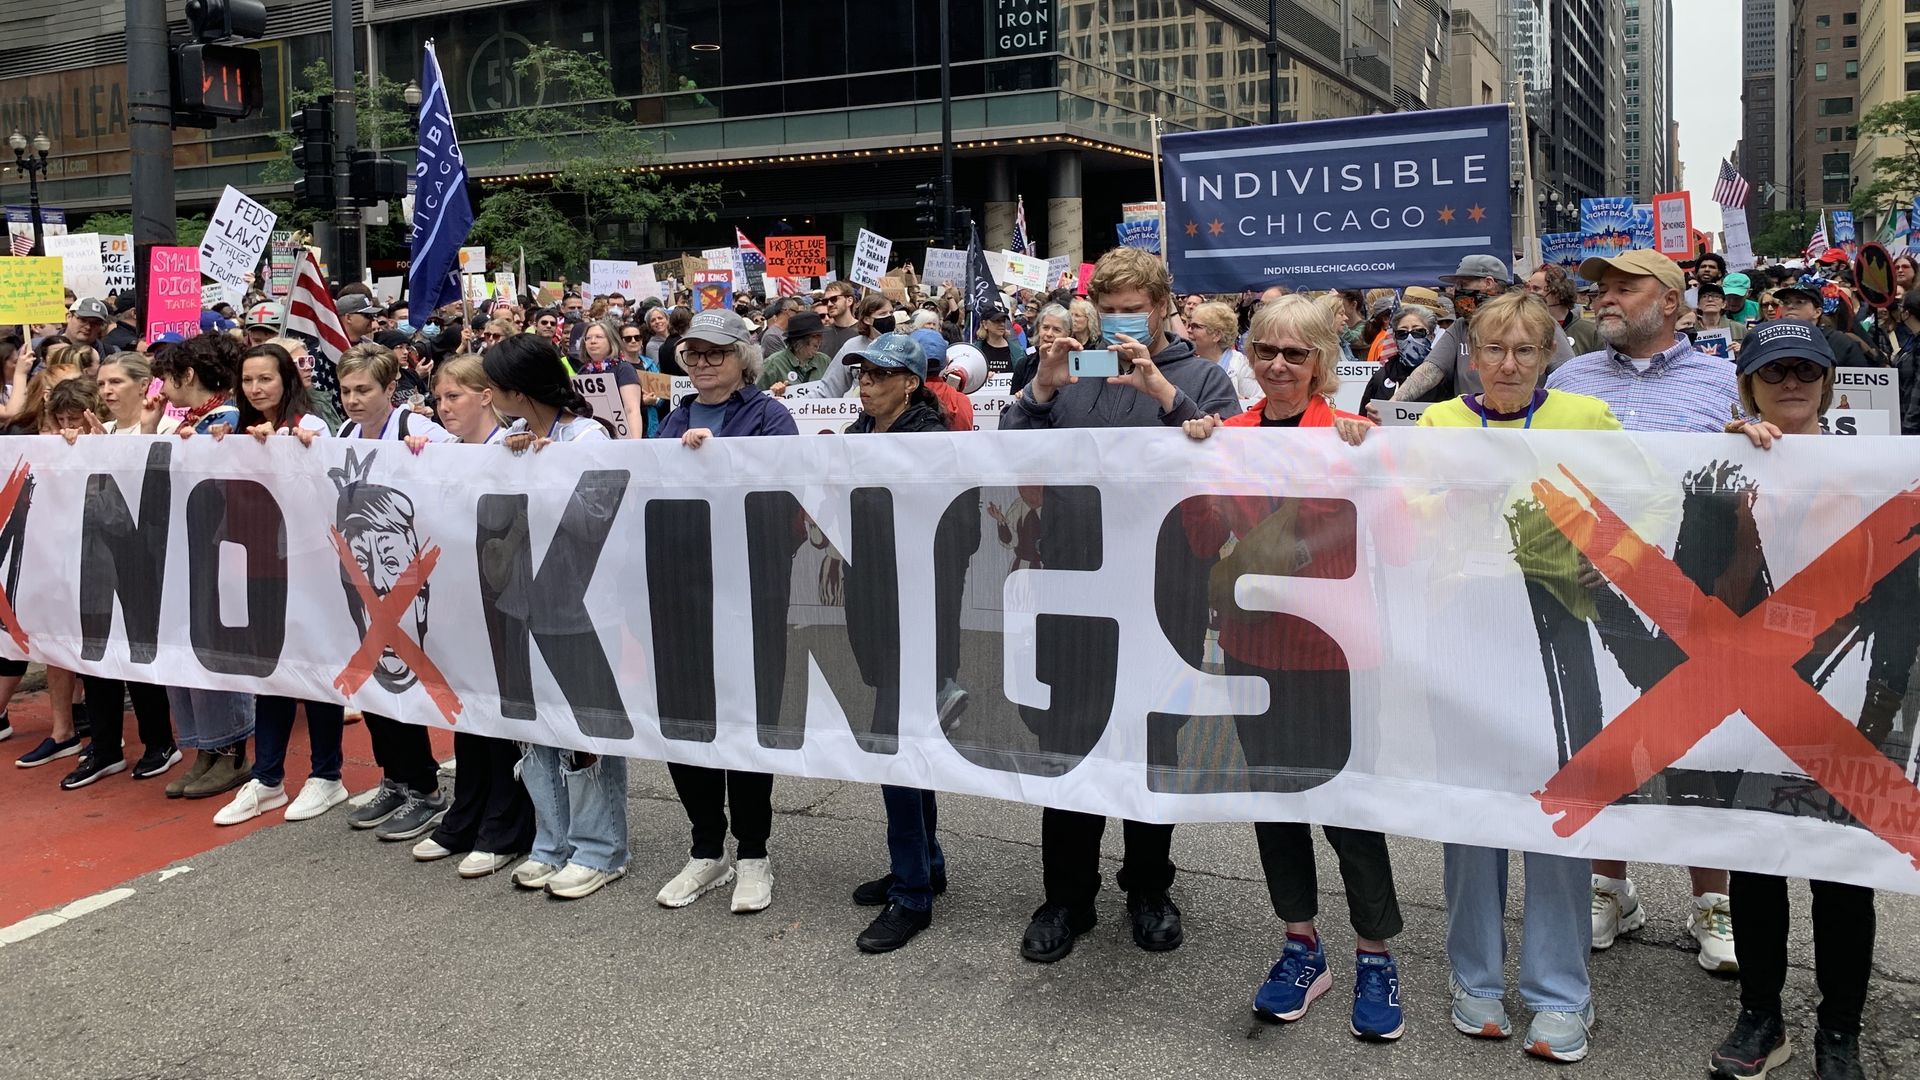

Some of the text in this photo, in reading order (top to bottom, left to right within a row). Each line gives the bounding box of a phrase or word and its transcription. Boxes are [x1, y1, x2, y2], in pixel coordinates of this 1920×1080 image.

[999, 9, 1048, 29] IRON
[999, 31, 1048, 49] GOLF
[1181, 154, 1487, 202] INDIVISIBLE
[1592, 204, 1610, 212] RISE
[234, 198, 273, 233] FEDS
[1586, 210, 1630, 220] FIGHT BACK
[1238, 206, 1425, 236] CHICAGO
[1126, 227, 1141, 235] RISE
[1635, 229, 1654, 237] BACK
[1122, 234, 1141, 244] FIGHT
[1550, 237, 1566, 245] RISE
[769, 240, 824, 251] PROTECT DUE
[101, 254, 124, 264] NOT
[219, 240, 252, 268] THUGS
[785, 249, 820, 258] PROCESS
[866, 249, 886, 264] PARADE
[153, 251, 200, 273] SMALL
[226, 260, 234, 270] 4
[768, 257, 785, 265] ICE
[209, 261, 243, 288] TRUMP
[787, 265, 817, 275] CITY!
[1263, 262, 1396, 276] INDIVISIBLECHICAGO.COM
[693, 272, 729, 283] NO KINGS
[157, 276, 200, 296] DICK
[165, 299, 198, 310] TATOR
[1758, 325, 1811, 339] INDIVISIBLE
[675, 381, 691, 389] OUR
[799, 403, 809, 414] of
[812, 403, 836, 415] Hate
[984, 398, 994, 411] of
[80, 441, 1358, 794] NO KINGS
